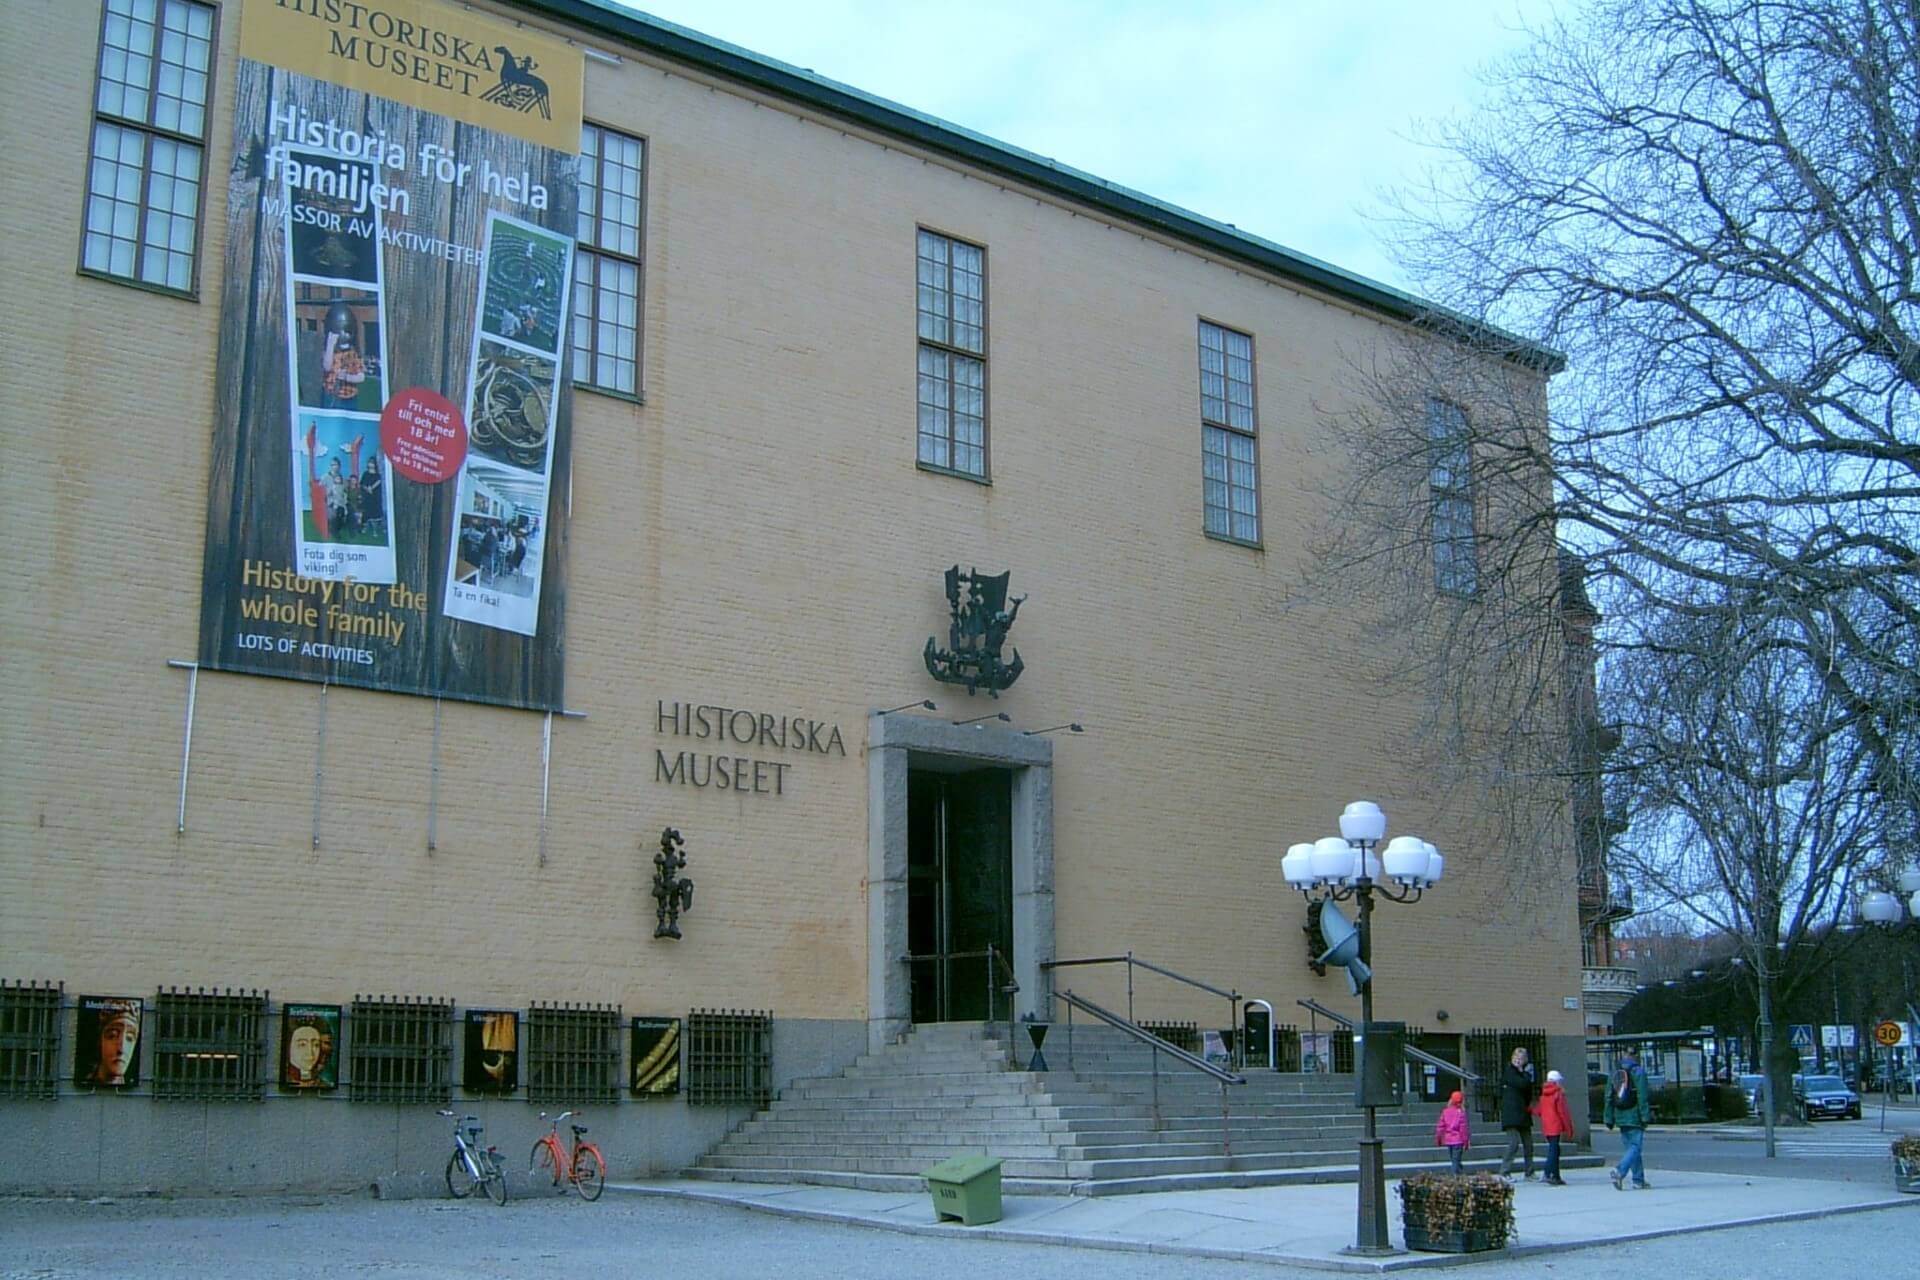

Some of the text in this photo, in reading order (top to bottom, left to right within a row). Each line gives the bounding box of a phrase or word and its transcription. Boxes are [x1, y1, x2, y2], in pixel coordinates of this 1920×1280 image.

[327, 29, 479, 97] MUSEET
[268, 100, 549, 211] Historia för hela
[265, 146, 411, 216] familjen
[261, 196, 341, 233] MASSOR
[348, 217, 374, 239] AV
[398, 409, 456, 438] till och med
[408, 399, 451, 424] Fri entré
[410, 426, 423, 438] 18
[303, 548, 368, 564] Fota dig som
[303, 560, 338, 576] viking!
[242, 558, 428, 612] History for the
[453, 586, 463, 598] Ta
[465, 593, 477, 602] en
[241, 597, 405, 646] whole family
[238, 632, 374, 666] LOTS OF ACTIVITIES
[657, 699, 847, 758] HISTORISKA
[655, 748, 792, 796] MUSEET
[1878, 1027, 1898, 1041] 30
